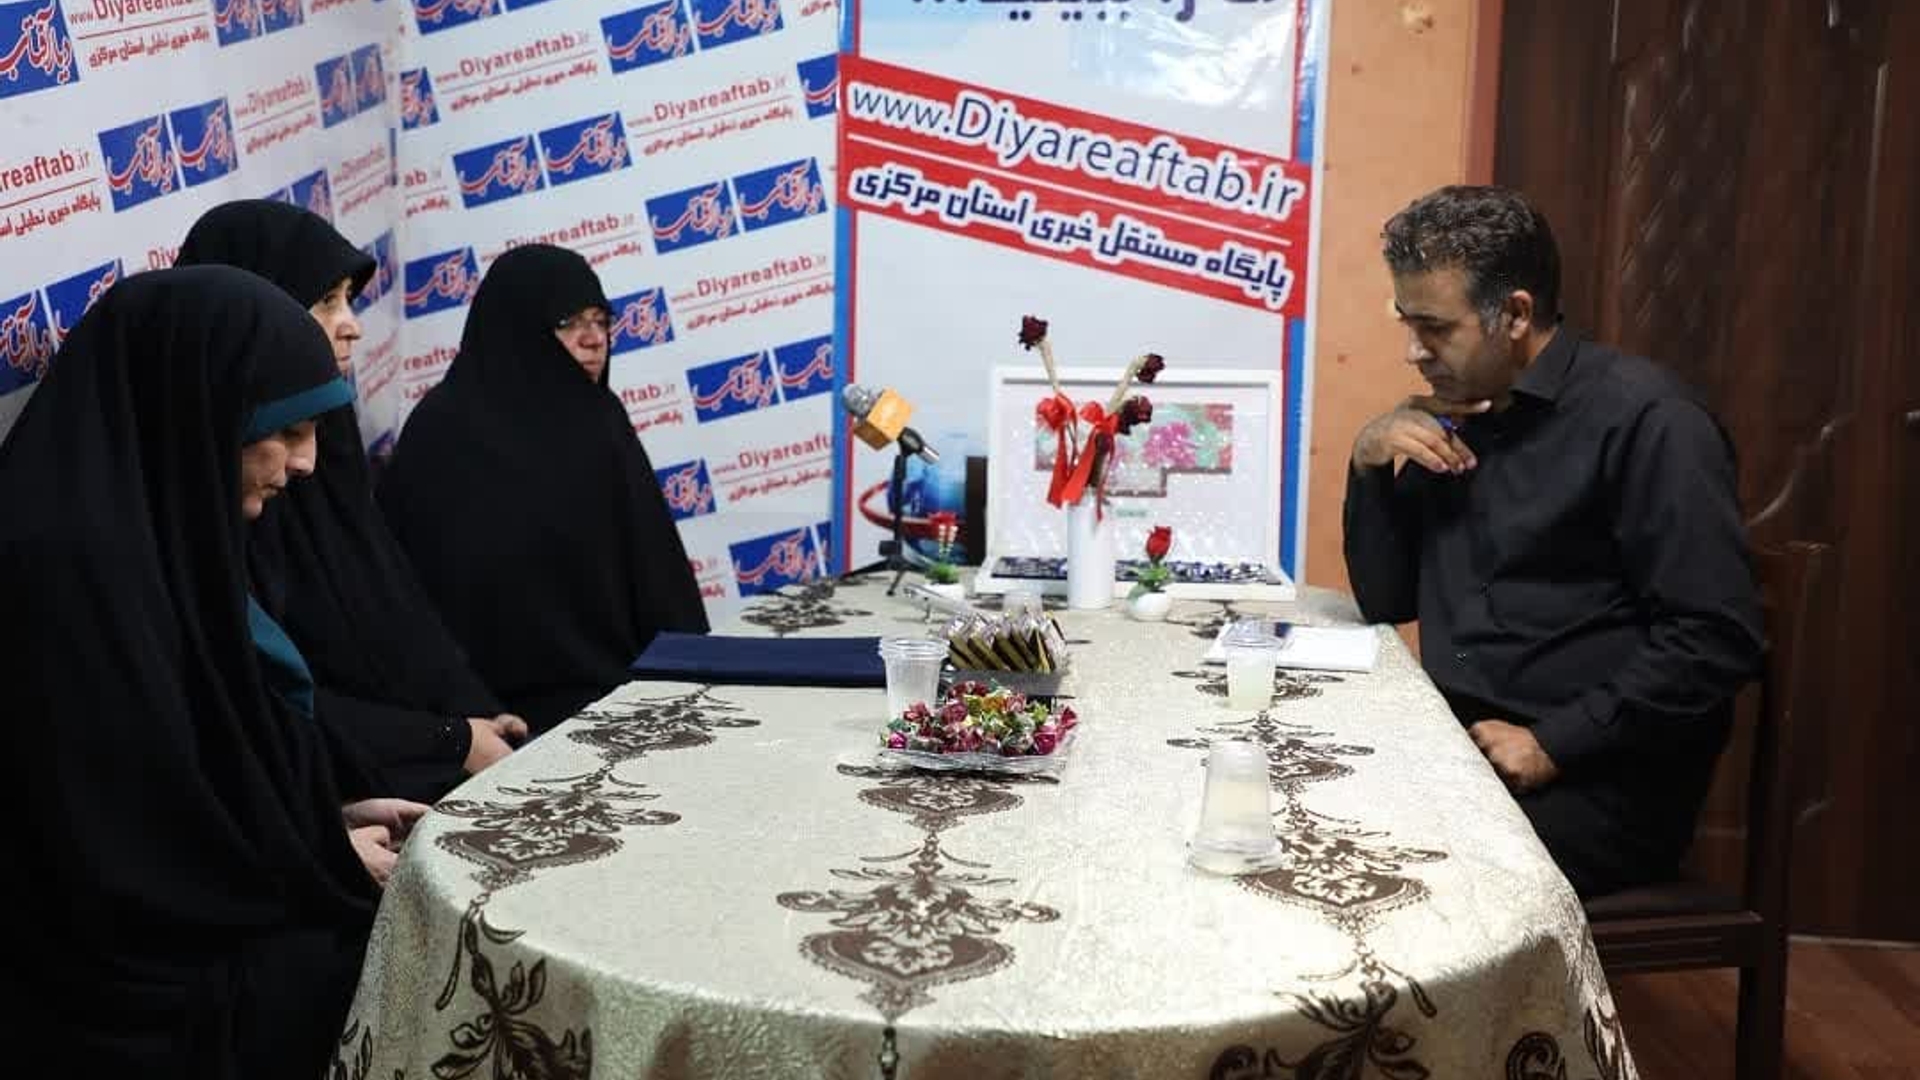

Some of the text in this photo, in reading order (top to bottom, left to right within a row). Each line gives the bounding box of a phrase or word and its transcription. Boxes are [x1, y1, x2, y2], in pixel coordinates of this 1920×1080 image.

[853, 88, 1298, 214] www.Diyareaftab.ir
[855, 170, 1287, 303] پایگاه مستقل خبری استان مرکزی
